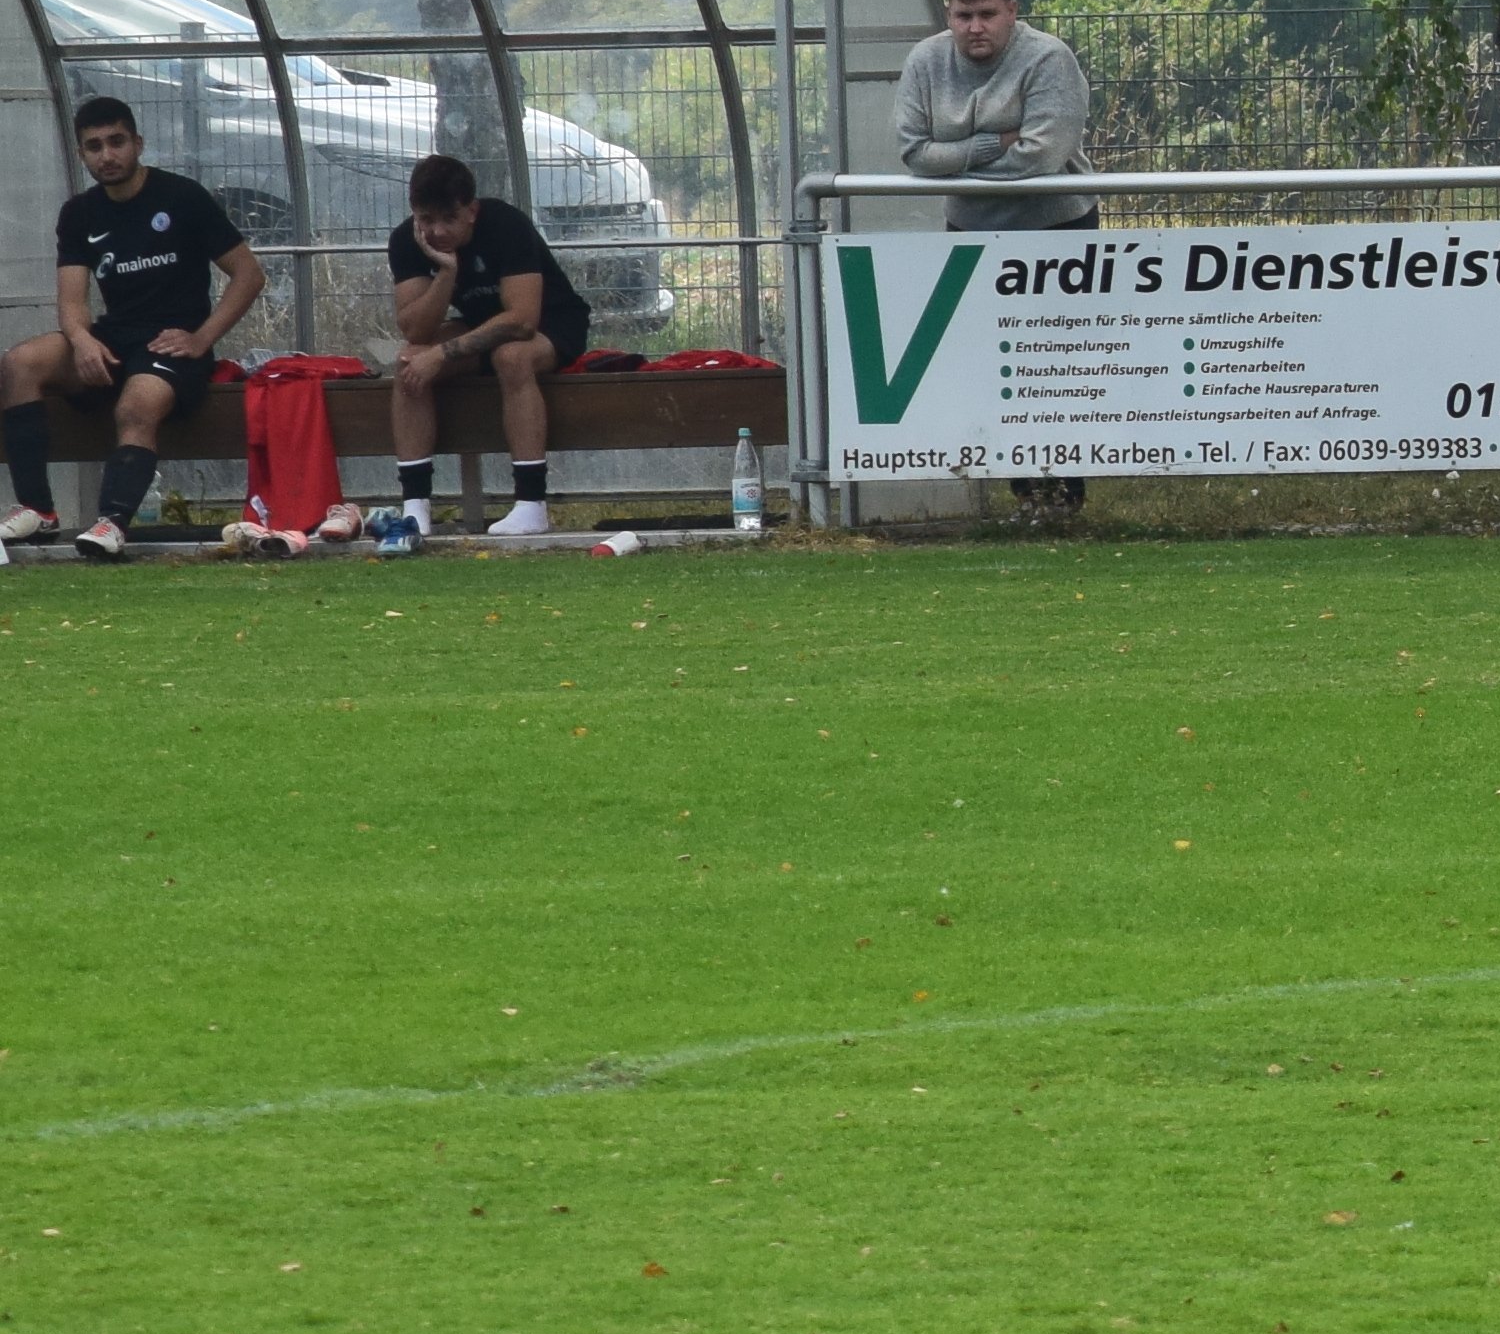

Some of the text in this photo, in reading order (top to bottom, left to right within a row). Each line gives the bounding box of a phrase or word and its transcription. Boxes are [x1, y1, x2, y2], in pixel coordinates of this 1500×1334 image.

[116, 252, 177, 274] mainova
[998, 312, 1322, 330] Wir erledigen für Sie gerne sämtliche Arbeiten:
[1015, 340, 1130, 354] Entrümpelungen
[1200, 337, 1284, 352] Umzugshilfe
[1016, 363, 1169, 378] Haushaltsauflösungen
[1200, 361, 1305, 374] Gartenarbeiten
[1017, 386, 1106, 400] Kleinumzüge
[1202, 381, 1379, 397] Einfache Hausreparaturen
[1001, 406, 1381, 424] und viele weitere Dienstleistungsarbeiten auf Anfrage.
[843, 448, 950, 474] Hauptstr.
[959, 446, 987, 468] 82
[1011, 444, 1082, 466] 61184
[1090, 442, 1175, 465] Karben
[1198, 441, 1237, 464] Tel.
[1245, 441, 1255, 463] /
[1263, 440, 1310, 462] Fax:
[1319, 437, 1482, 462] 06039-939383
